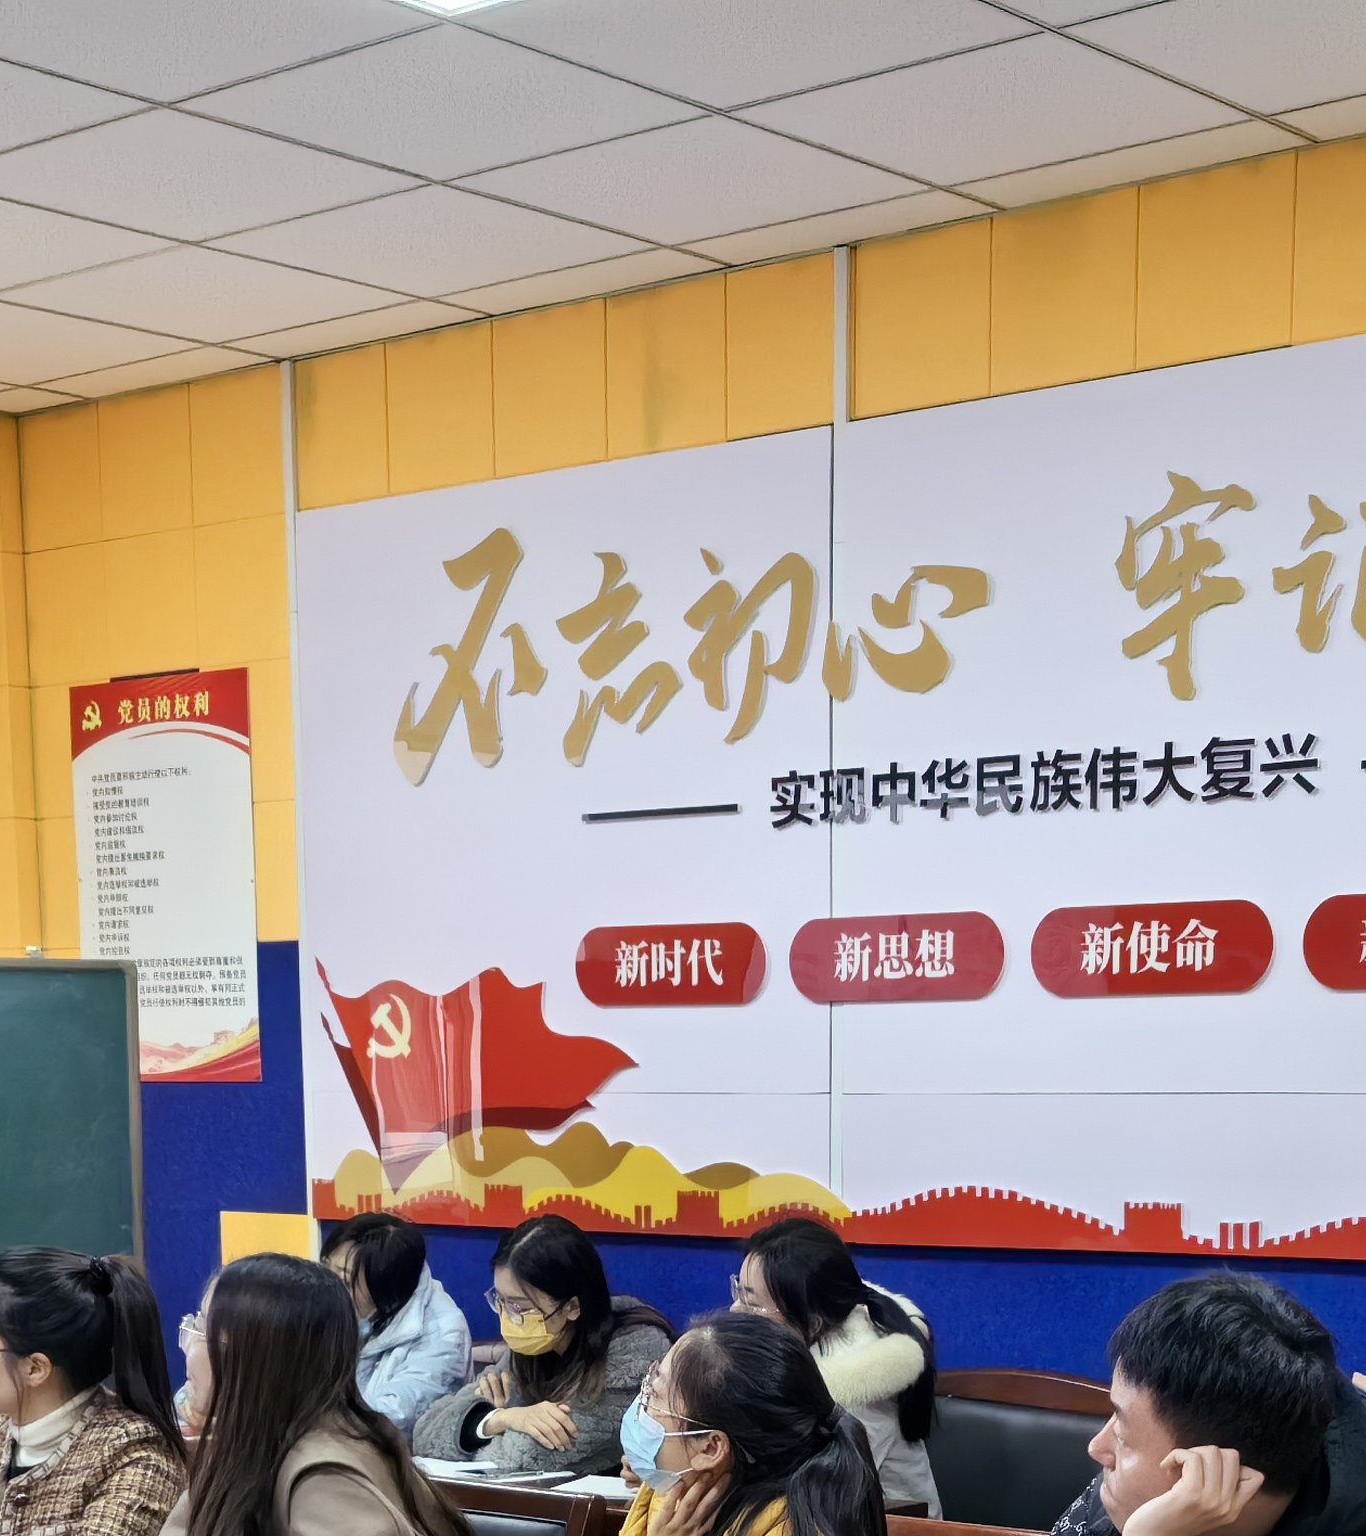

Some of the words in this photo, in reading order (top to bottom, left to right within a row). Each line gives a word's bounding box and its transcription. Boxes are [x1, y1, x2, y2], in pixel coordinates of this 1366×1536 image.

[393, 528, 992, 786] 不忘初心
[118, 691, 209, 724] 党员的权利
[770, 733, 1321, 829] 实现中华民族伟大复兴
[615, 939, 723, 988] 新时代
[834, 929, 955, 983] 新思想
[1080, 918, 1219, 975] 新使命
